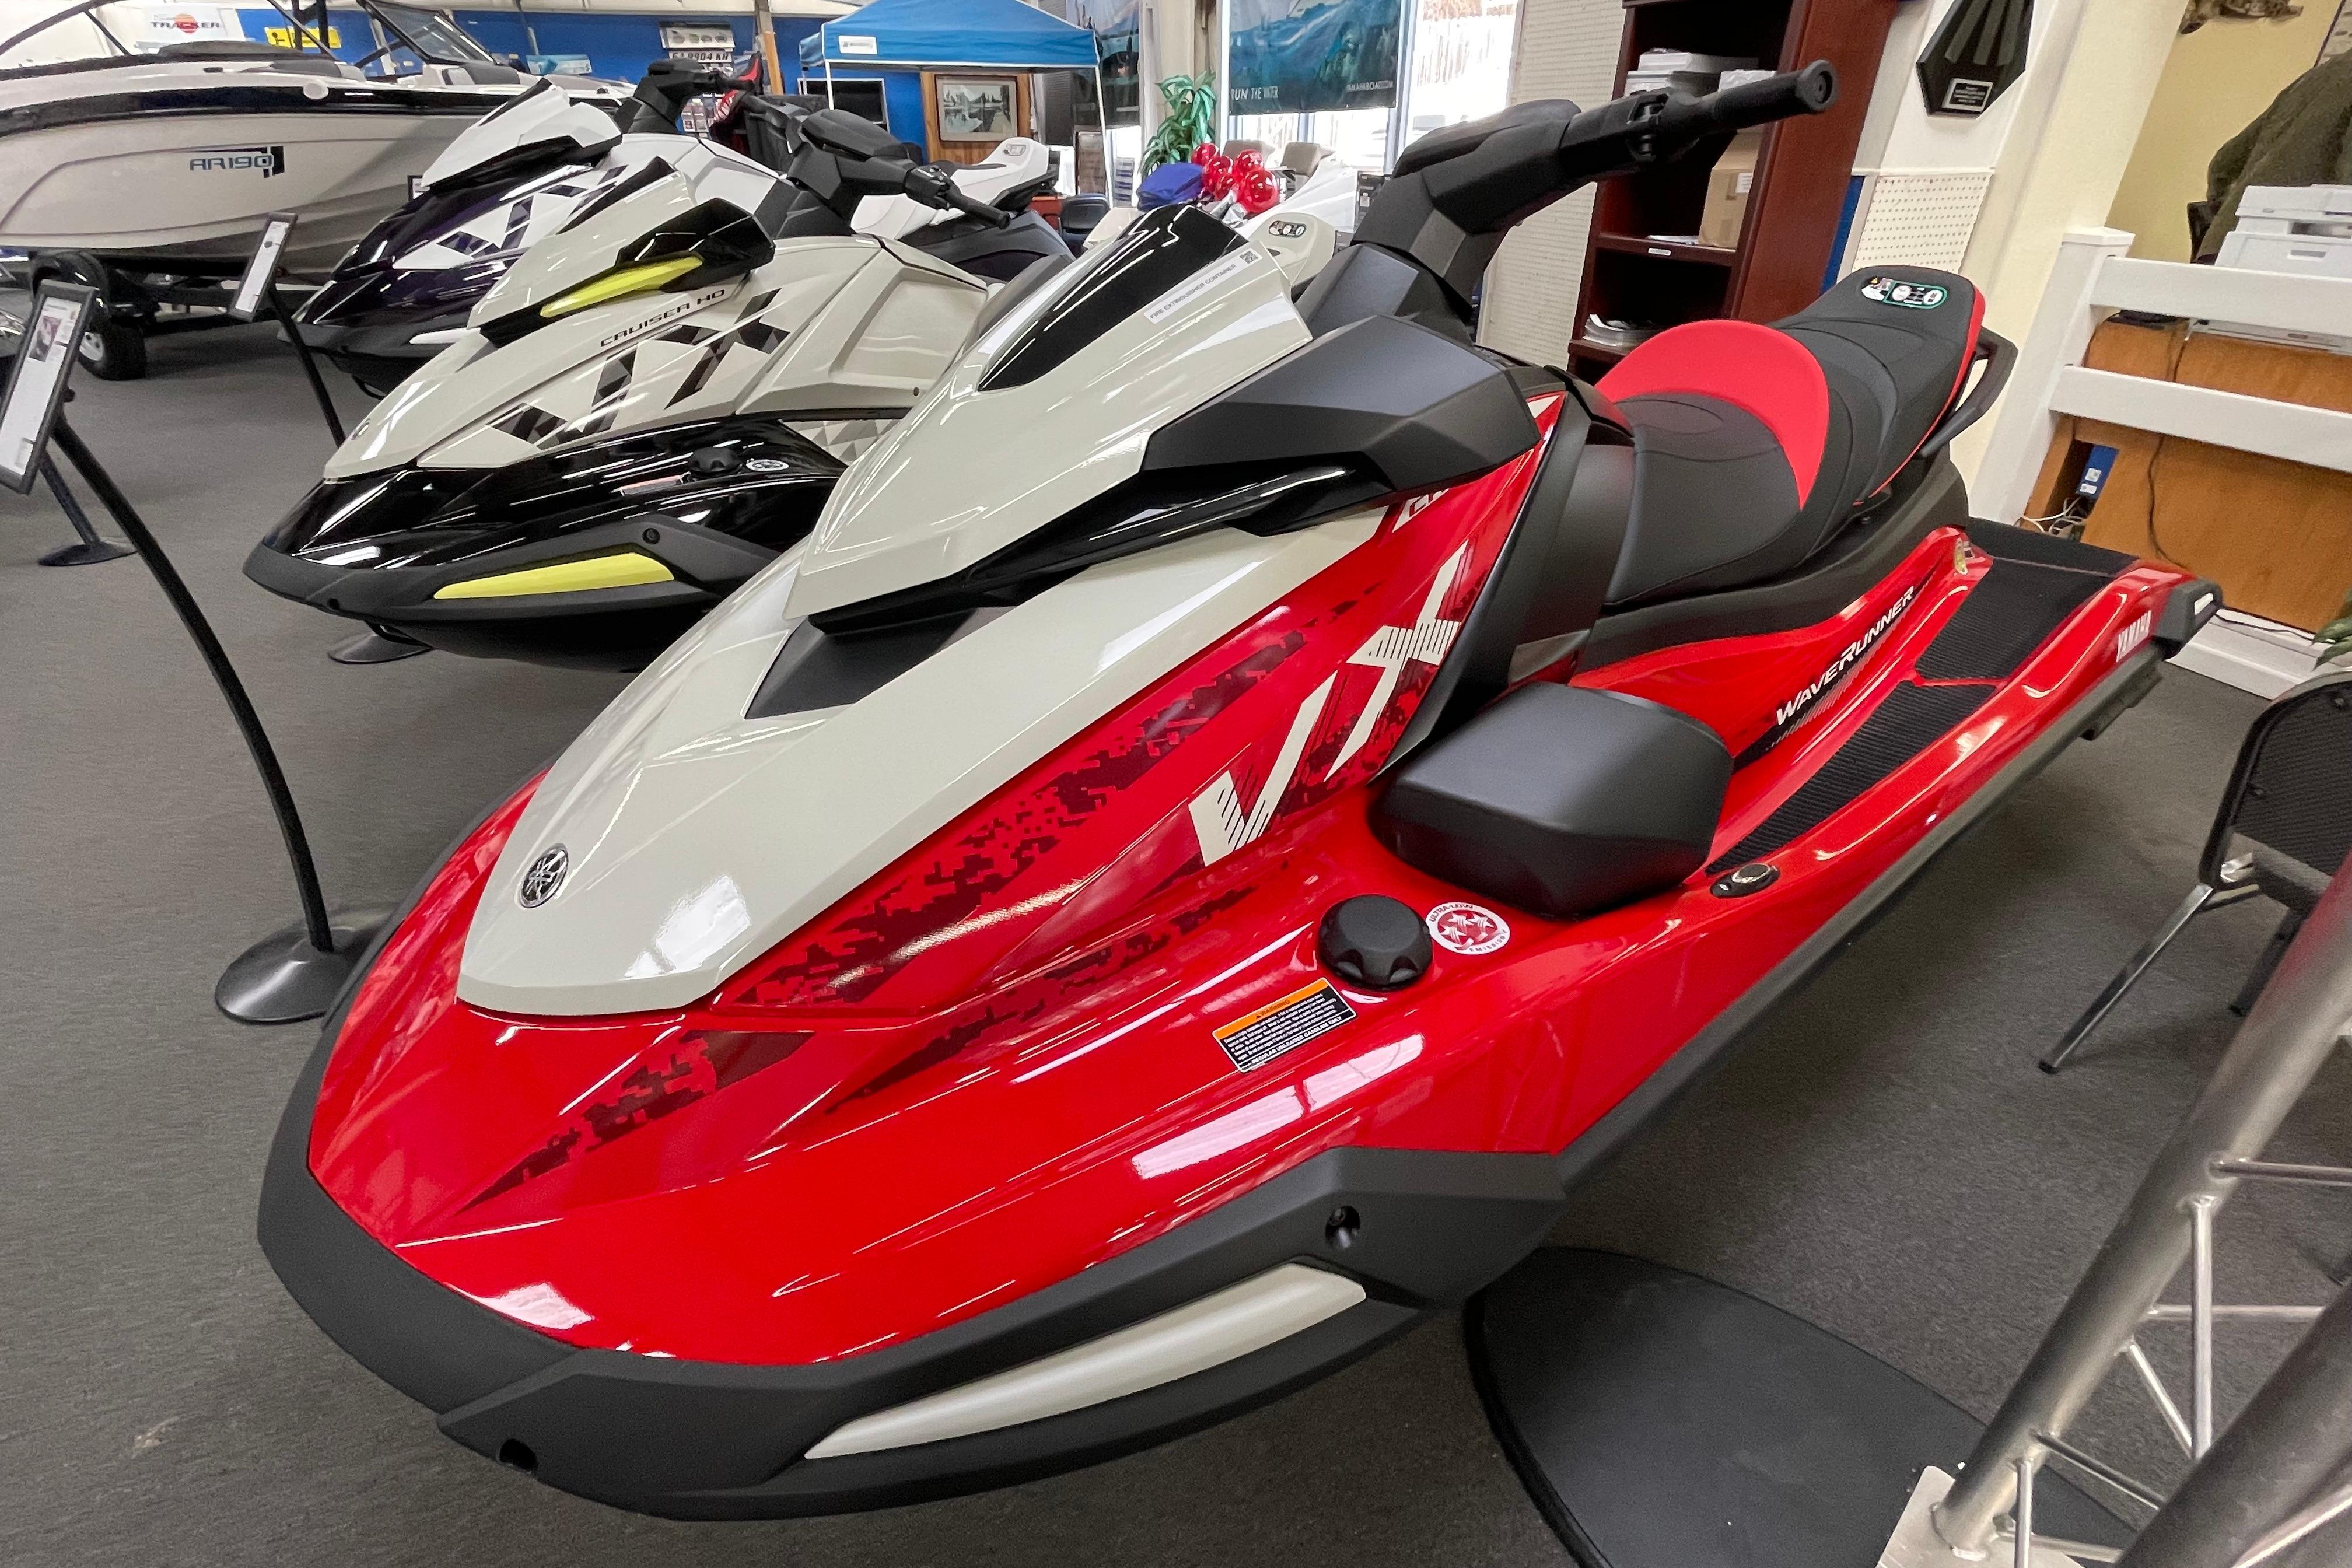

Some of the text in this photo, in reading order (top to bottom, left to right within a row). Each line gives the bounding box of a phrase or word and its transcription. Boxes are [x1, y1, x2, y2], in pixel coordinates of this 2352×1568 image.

[1231, 88, 1248, 100] RUN
[190, 155, 272, 170] AR190
[601, 290, 725, 346] CRUISER HO
[1150, 308, 1165, 320] FIRE
[1776, 586, 1914, 725] WAVERUNNER
[1188, 538, 1469, 867] VX
